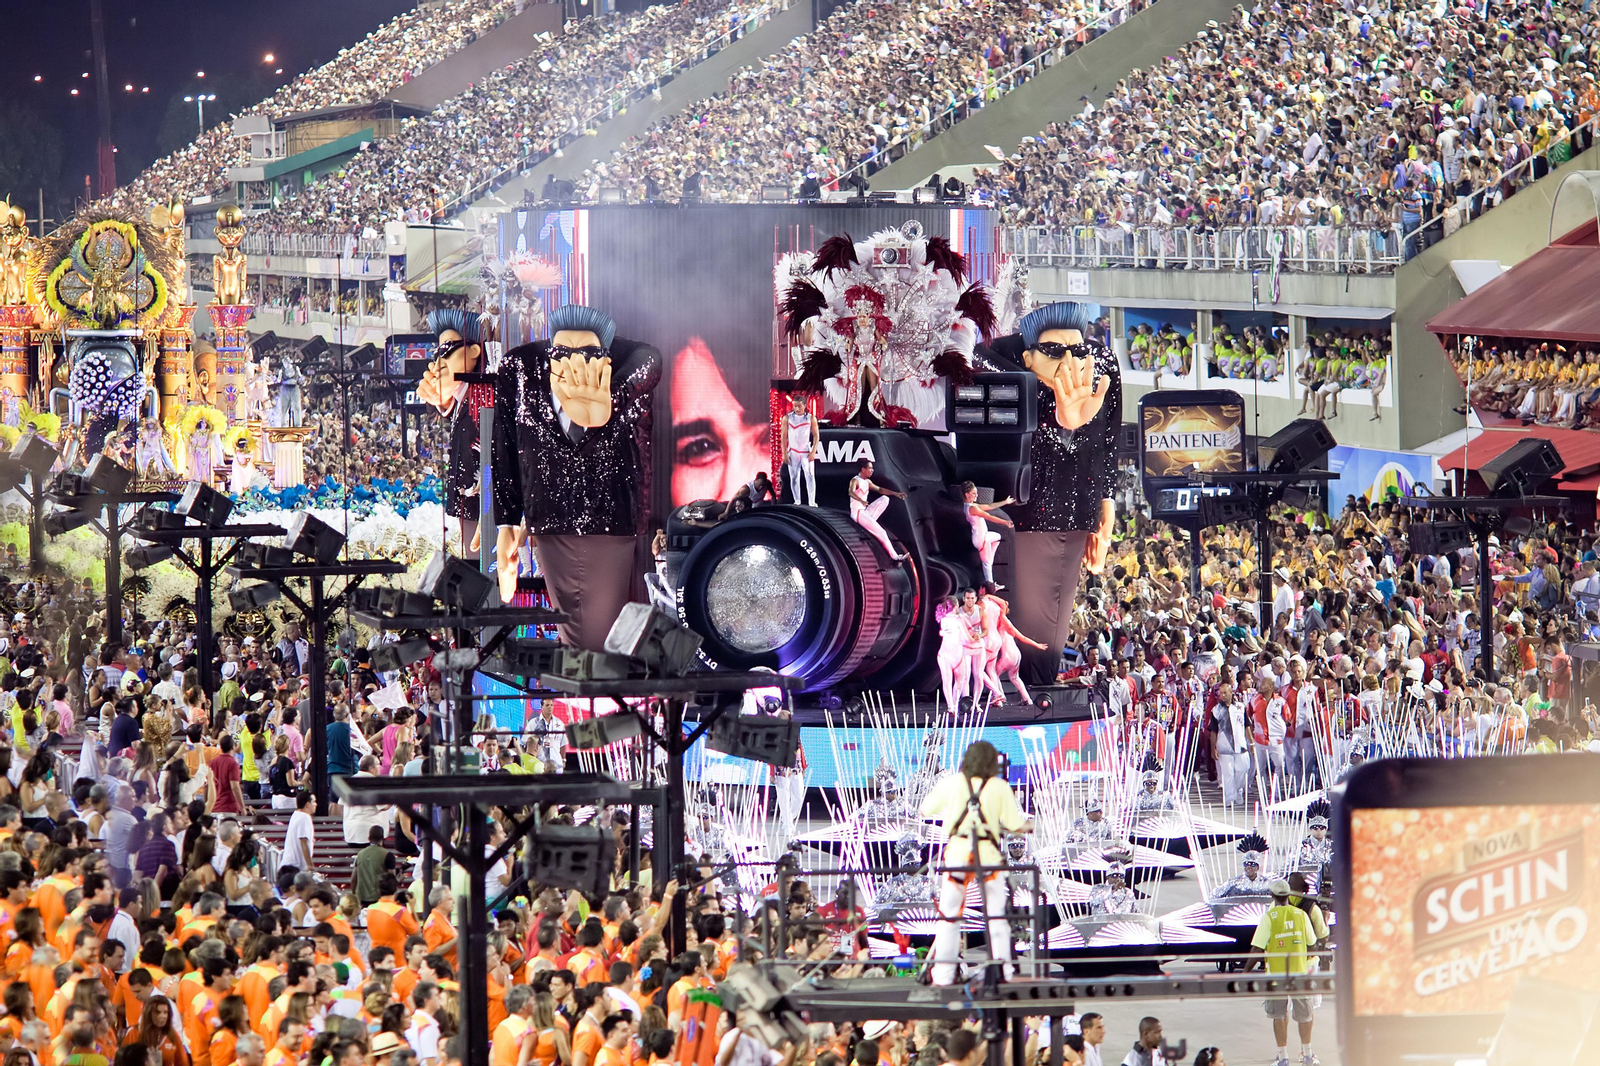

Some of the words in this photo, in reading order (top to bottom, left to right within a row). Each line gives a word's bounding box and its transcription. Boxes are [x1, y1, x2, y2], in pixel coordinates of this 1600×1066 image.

[809, 440, 876, 463] AMA
[1150, 433, 1221, 449] PANTENE
[1472, 831, 1522, 861] NOVA
[1426, 849, 1569, 935] SCHIN
[1284, 920, 1294, 930] TV
[1414, 907, 1588, 997] CERVEJÃO
